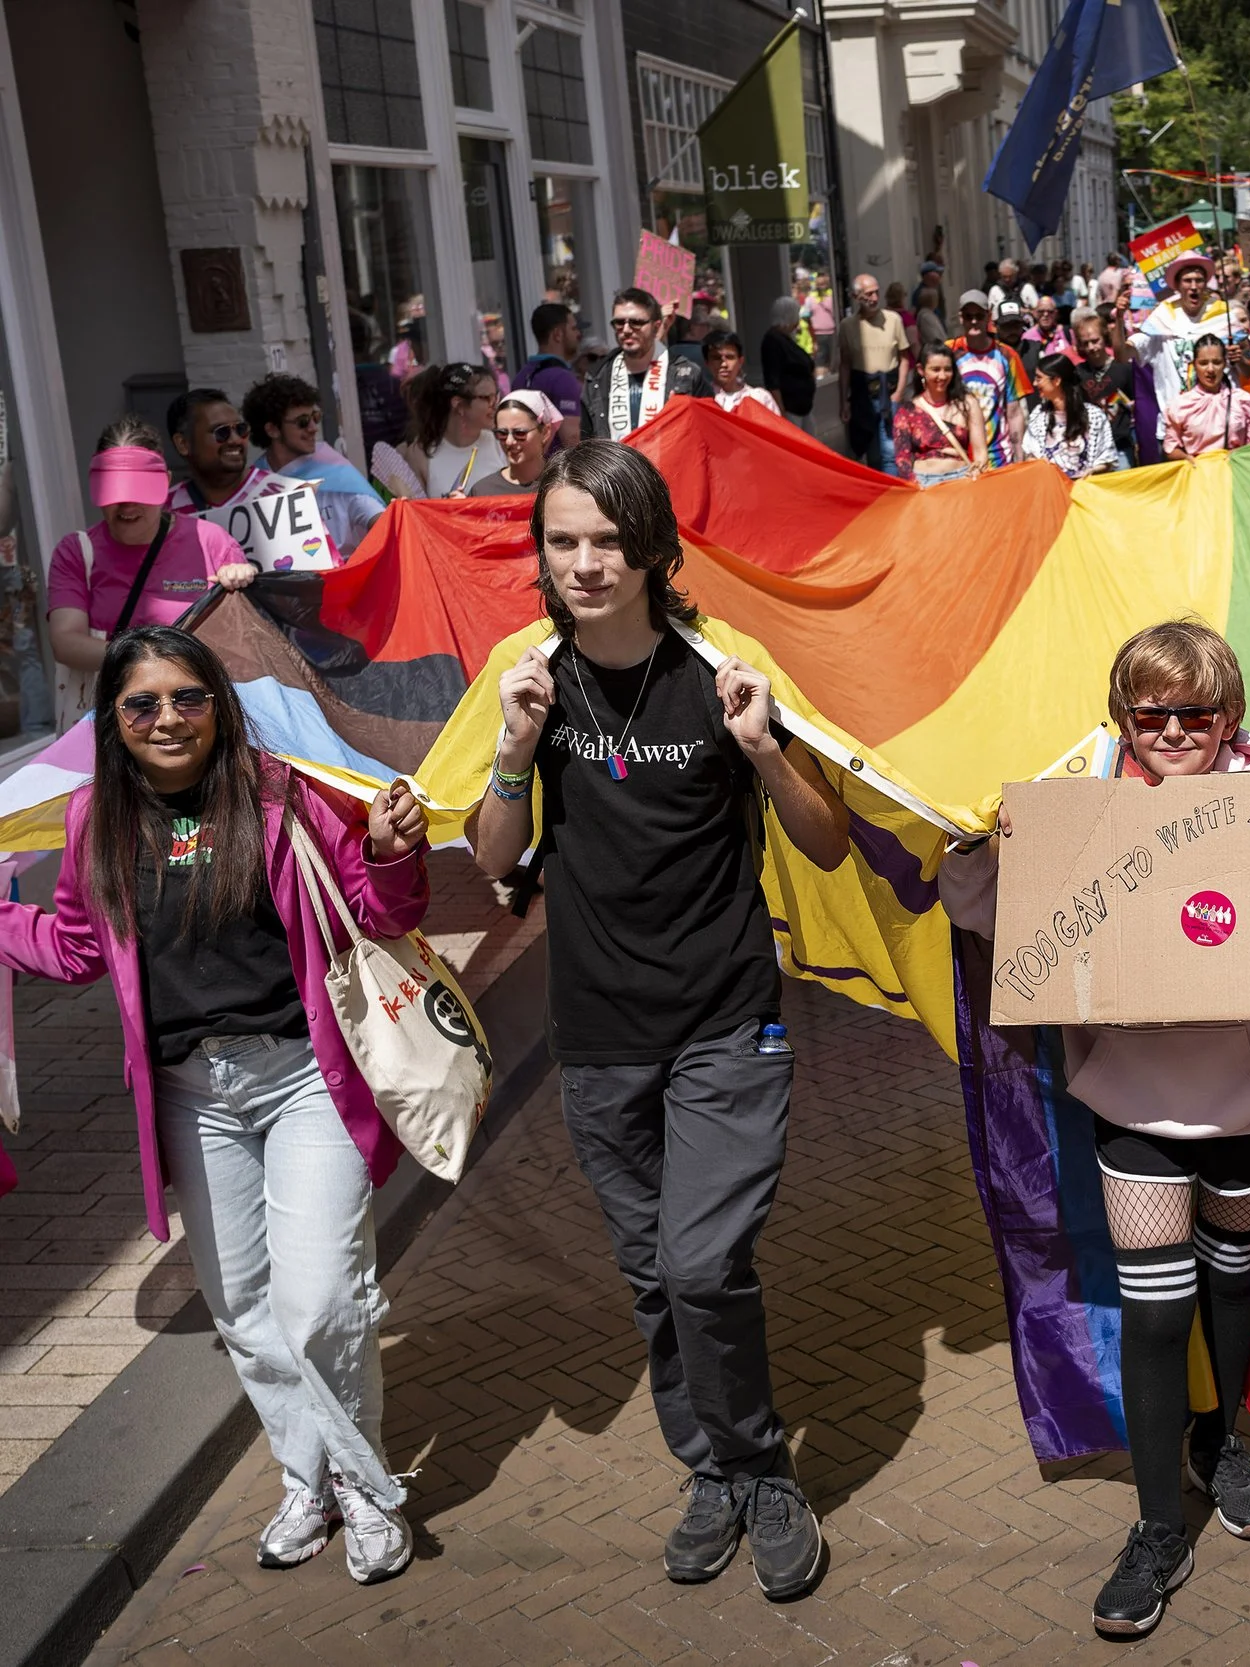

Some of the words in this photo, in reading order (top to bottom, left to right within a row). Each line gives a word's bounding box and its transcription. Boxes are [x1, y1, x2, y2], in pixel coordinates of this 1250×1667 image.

[708, 163, 801, 192] bliek
[713, 221, 804, 242] DWAALGEBIED
[1141, 242, 1160, 258] WE
[1164, 231, 1186, 248] ALL
[642, 231, 694, 282] PRIDE
[228, 490, 313, 546] OVE
[994, 929, 1059, 1001] TOO
[1053, 879, 1109, 938] GAY
[1105, 845, 1153, 893] TO
[398, 967, 428, 1008] BEN
